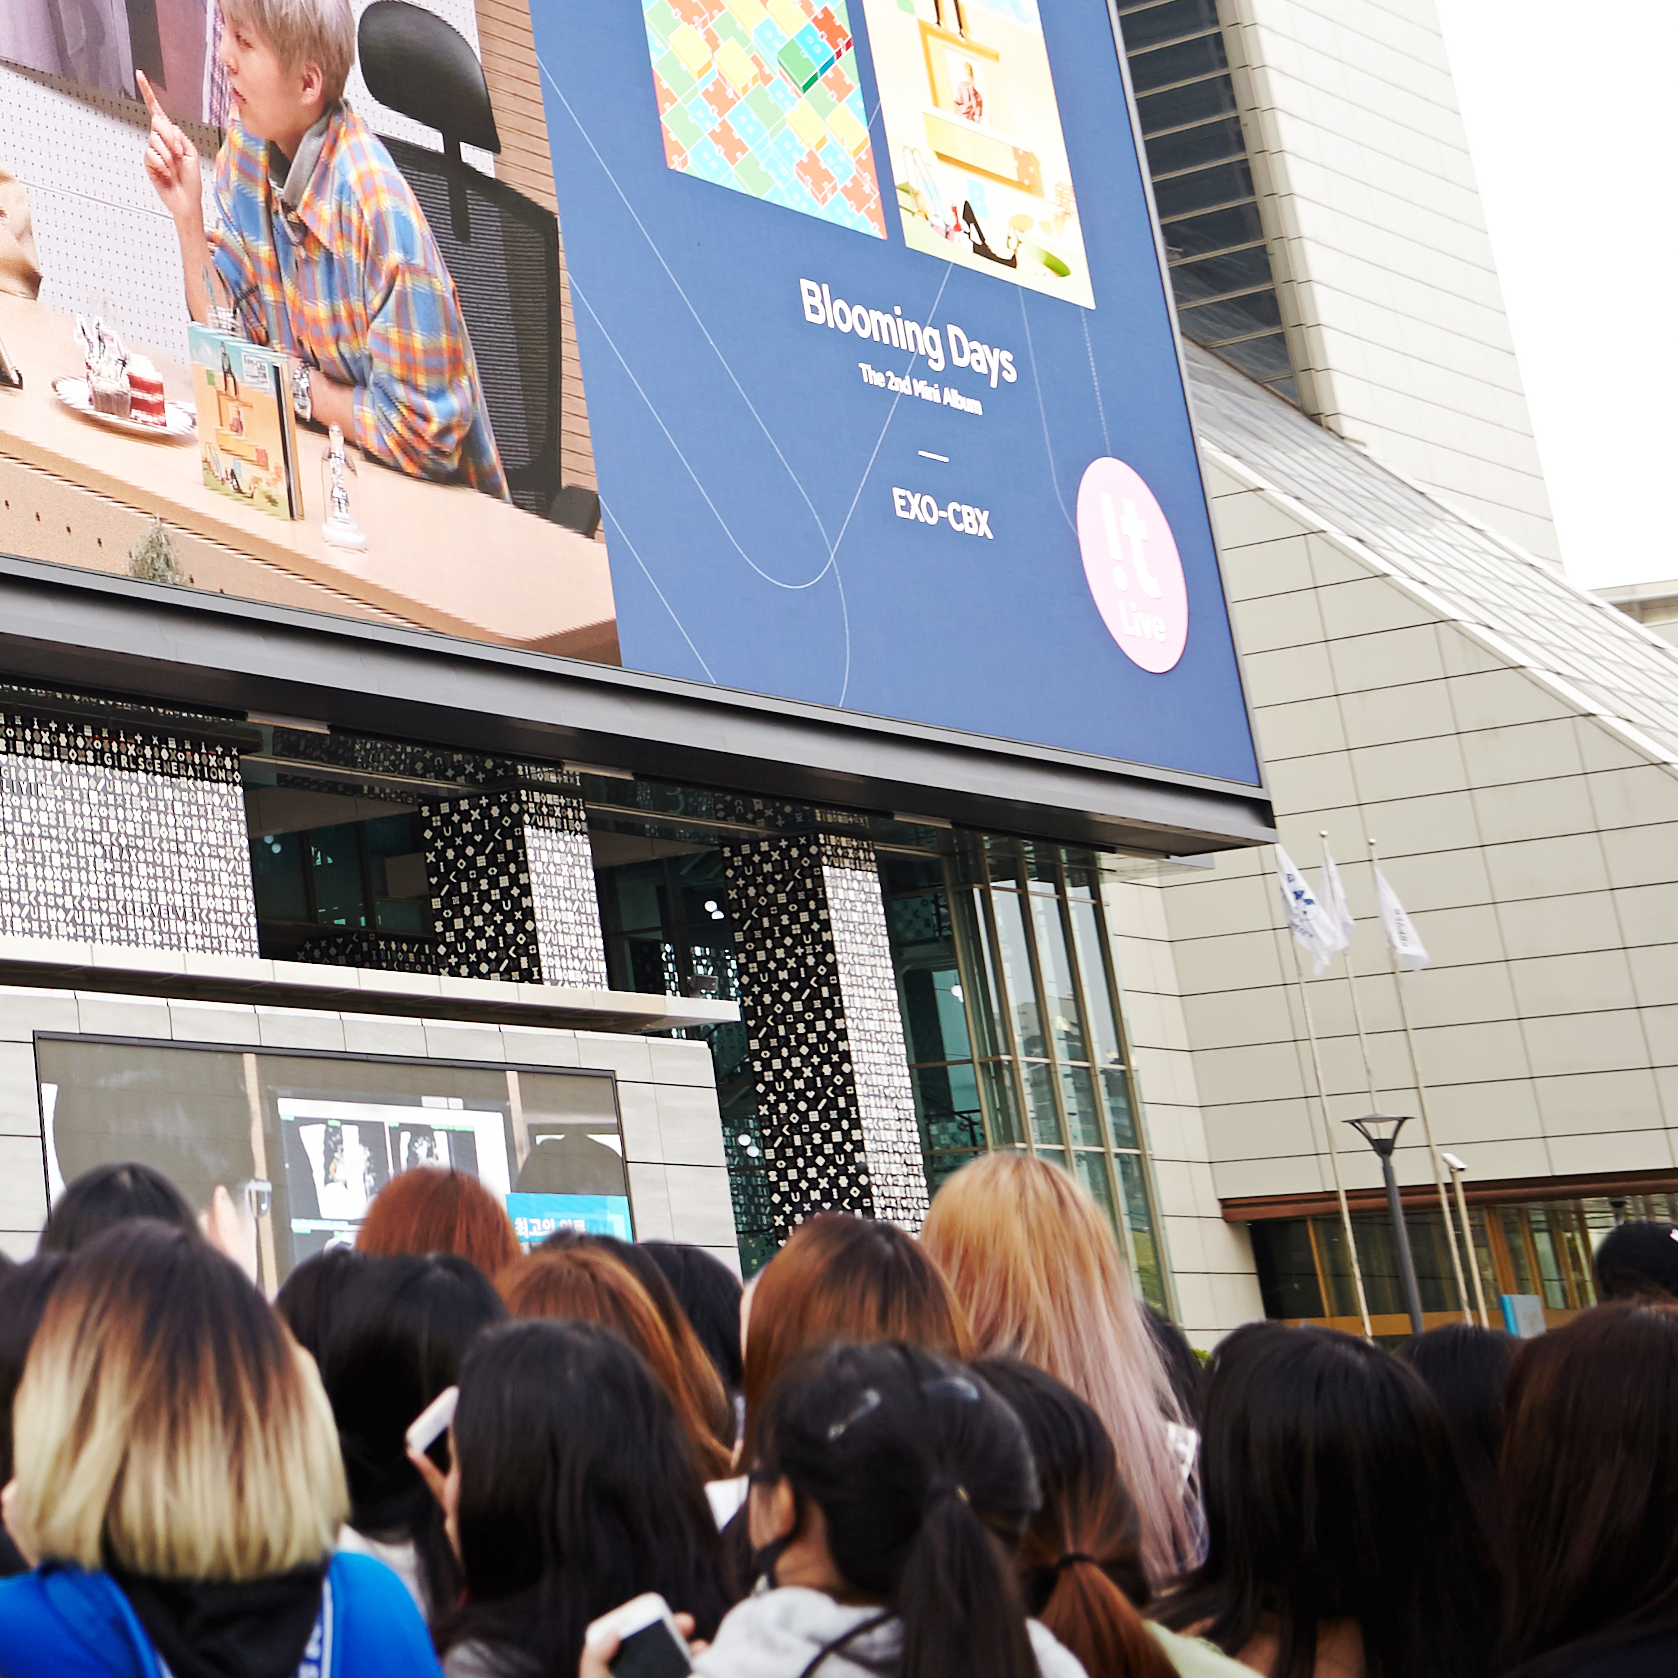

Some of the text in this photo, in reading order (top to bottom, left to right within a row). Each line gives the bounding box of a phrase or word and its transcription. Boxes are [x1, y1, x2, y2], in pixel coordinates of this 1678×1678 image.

[799, 277, 1018, 389] Blooming Days
[858, 362, 984, 416] The 2nd Mini Album
[892, 486, 995, 540] EXO-CBX
[1118, 598, 1167, 643] Live
